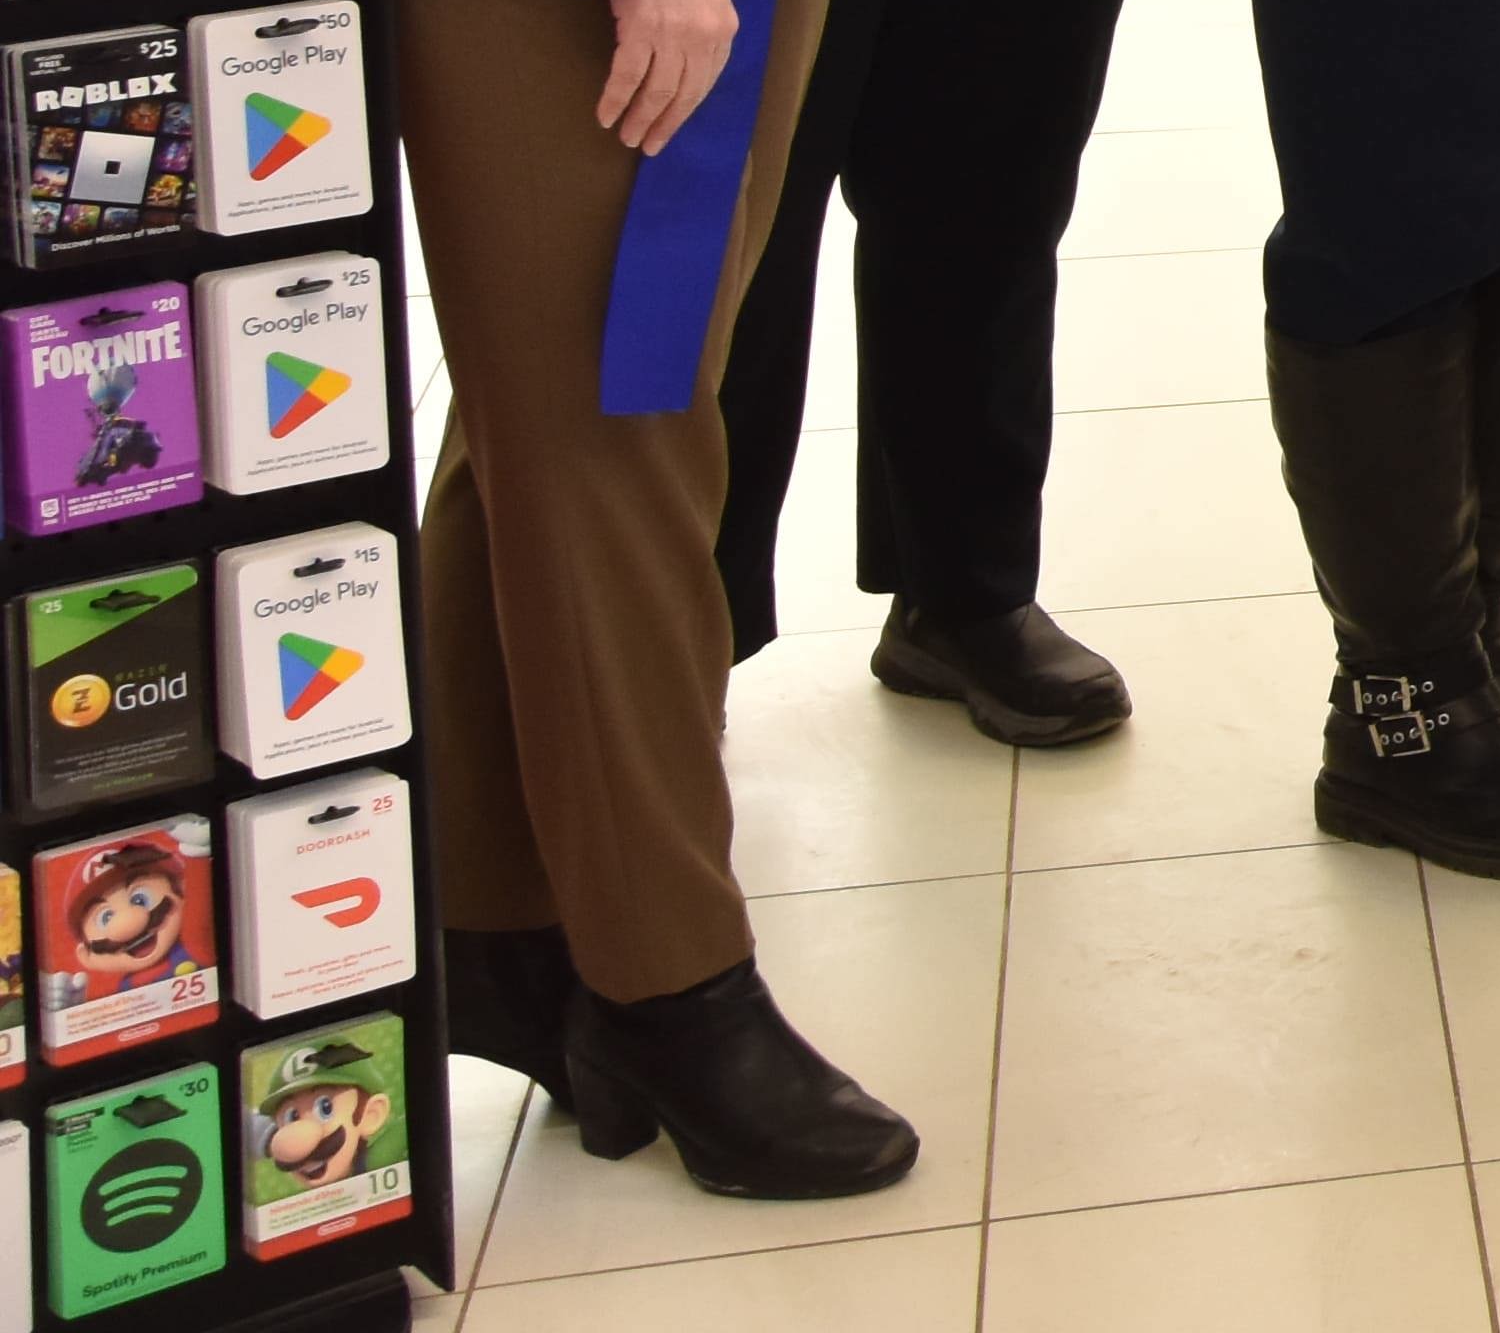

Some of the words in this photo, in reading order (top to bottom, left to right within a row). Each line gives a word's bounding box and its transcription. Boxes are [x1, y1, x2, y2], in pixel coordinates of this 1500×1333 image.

[319, 13, 350, 29] $50
[140, 39, 177, 59] $25
[221, 50, 298, 76] Google
[305, 45, 348, 66] Play
[36, 73, 177, 112] ROBLOX
[51, 239, 93, 251] Discover
[95, 232, 132, 245] Millions
[134, 228, 145, 237] of
[342, 269, 370, 286] $25
[152, 297, 180, 312] $20
[243, 309, 319, 336] Google
[326, 302, 368, 322] Play
[32, 321, 183, 388] FORTNITE
[355, 547, 380, 564] $15
[254, 586, 330, 618] Google
[338, 579, 379, 602] Play
[115, 672, 188, 711] Gold
[372, 795, 393, 811] 25
[296, 828, 371, 855] DOORDASH
[171, 974, 206, 1004] 25
[369, 1167, 399, 1194] 10
[83, 1273, 139, 1299] Spotify
[142, 1249, 207, 1280] Premium
